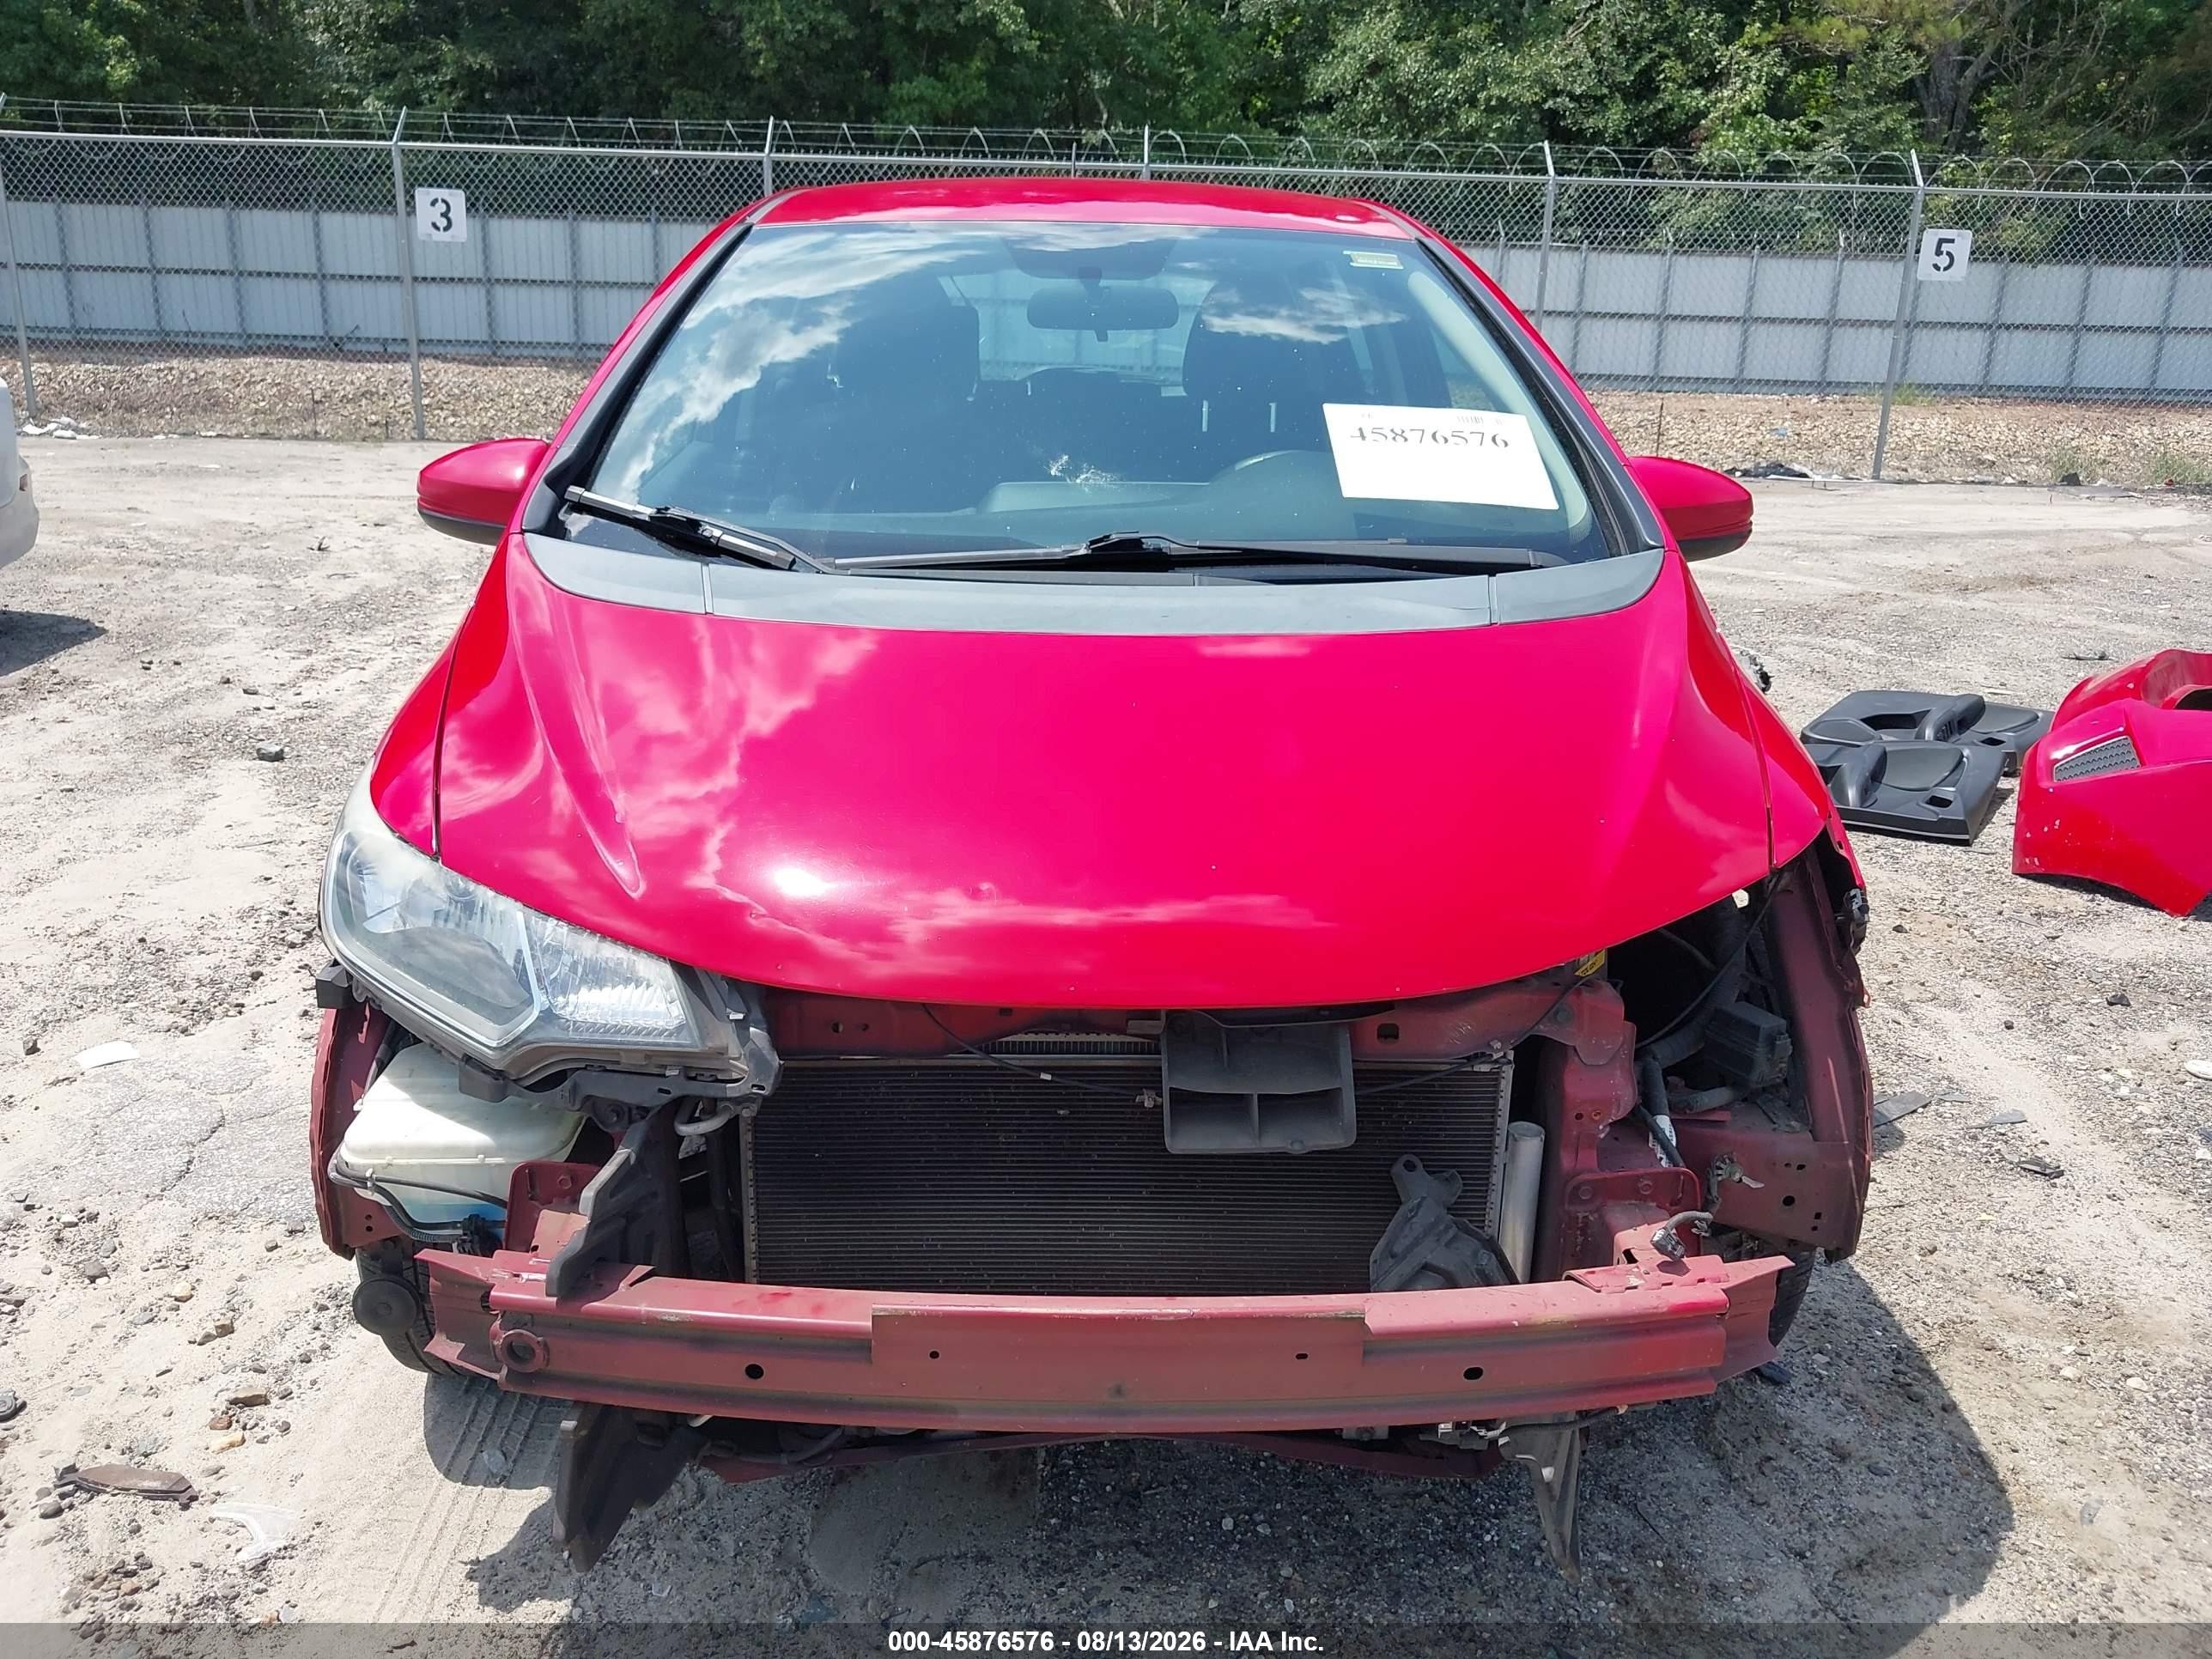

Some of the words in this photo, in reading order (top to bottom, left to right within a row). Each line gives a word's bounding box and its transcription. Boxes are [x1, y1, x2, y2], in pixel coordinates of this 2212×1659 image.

[429, 197, 453, 233] 3
[1931, 237, 1955, 272] 5
[1349, 426, 1510, 448] 45876576
